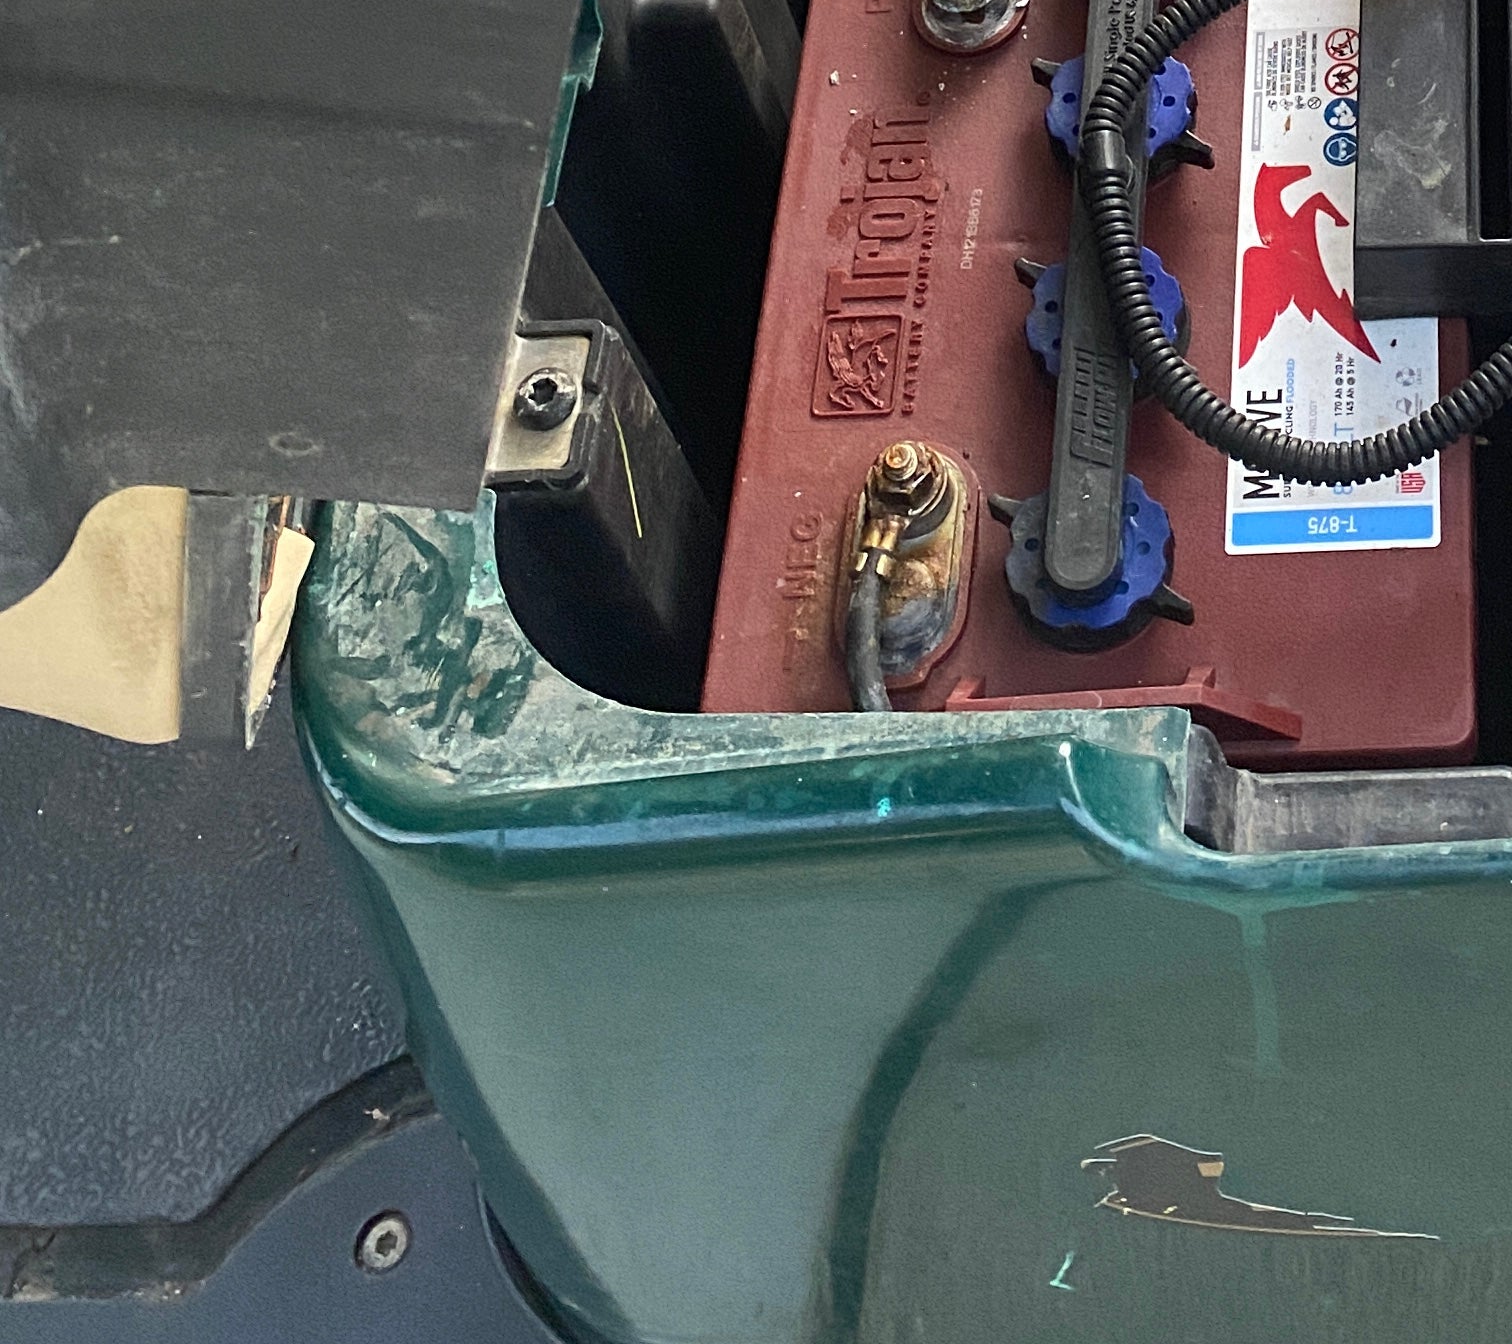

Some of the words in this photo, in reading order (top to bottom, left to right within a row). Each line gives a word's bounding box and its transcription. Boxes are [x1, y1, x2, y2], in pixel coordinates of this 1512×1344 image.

[1104, 18, 1122, 62] Single
[824, 115, 938, 313] Trojan
[901, 321, 924, 415] BATTERY
[913, 211, 936, 308] COMPANY
[1336, 352, 1344, 362] Hr
[1346, 357, 1355, 366] Hr
[1285, 358, 1295, 402] FLOODED
[1334, 387, 1344, 399] Ah
[1346, 387, 1355, 399] Ah
[1334, 400, 1344, 416] 170
[1345, 401, 1354, 416] 145
[1400, 472, 1426, 494] USA
[1307, 516, 1358, 534] T-875
